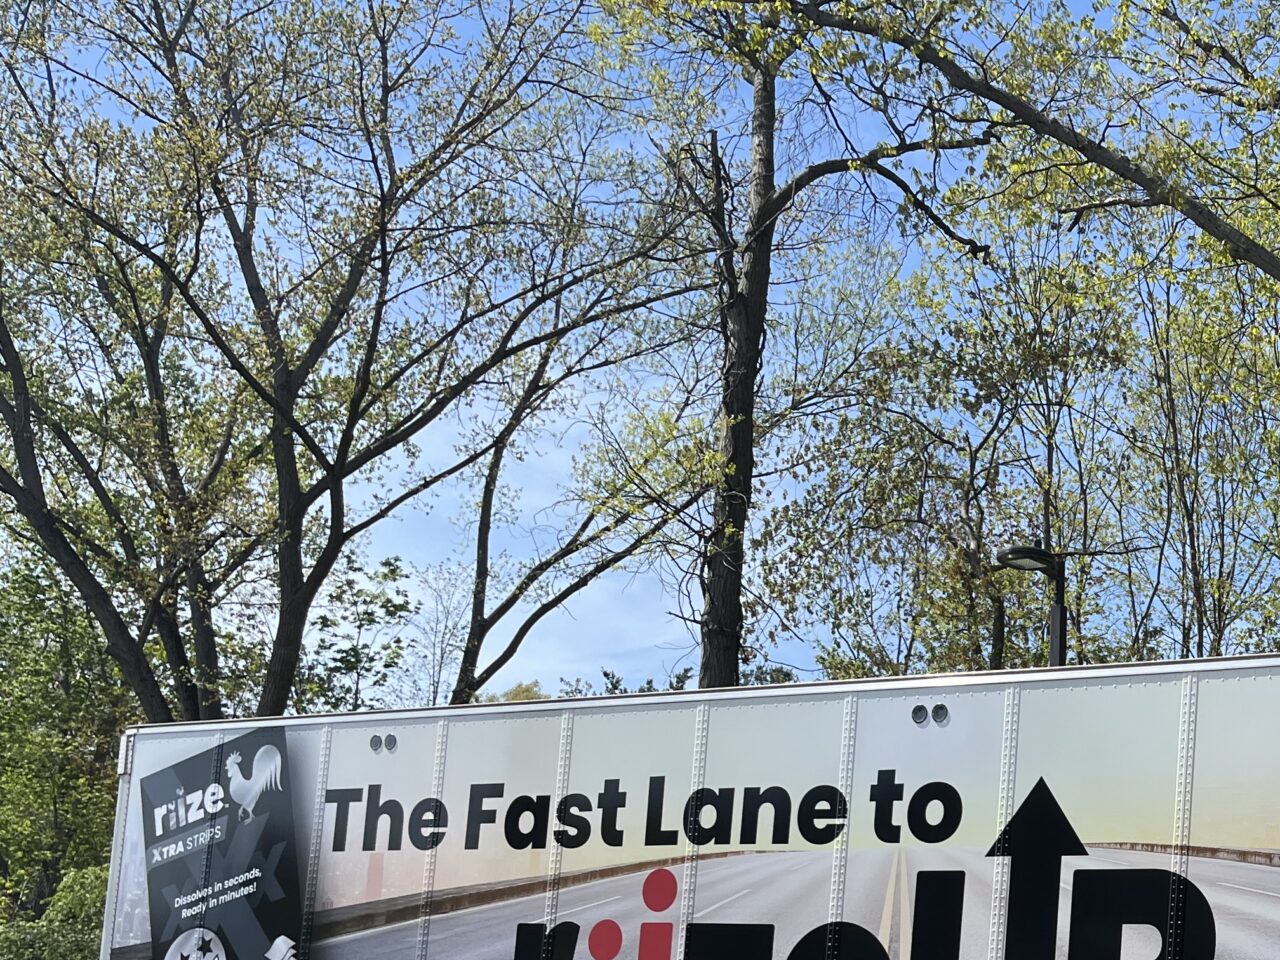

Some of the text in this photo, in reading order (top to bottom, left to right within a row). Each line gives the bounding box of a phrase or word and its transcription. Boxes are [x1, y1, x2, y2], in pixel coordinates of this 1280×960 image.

[154, 783, 225, 836] riize
[324, 769, 963, 852] The Fast Lane to
[152, 826, 222, 864] XTRA STRIPS
[174, 868, 262, 908] Dissolves in seconds,
[181, 882, 257, 919] Ready in minutes!
